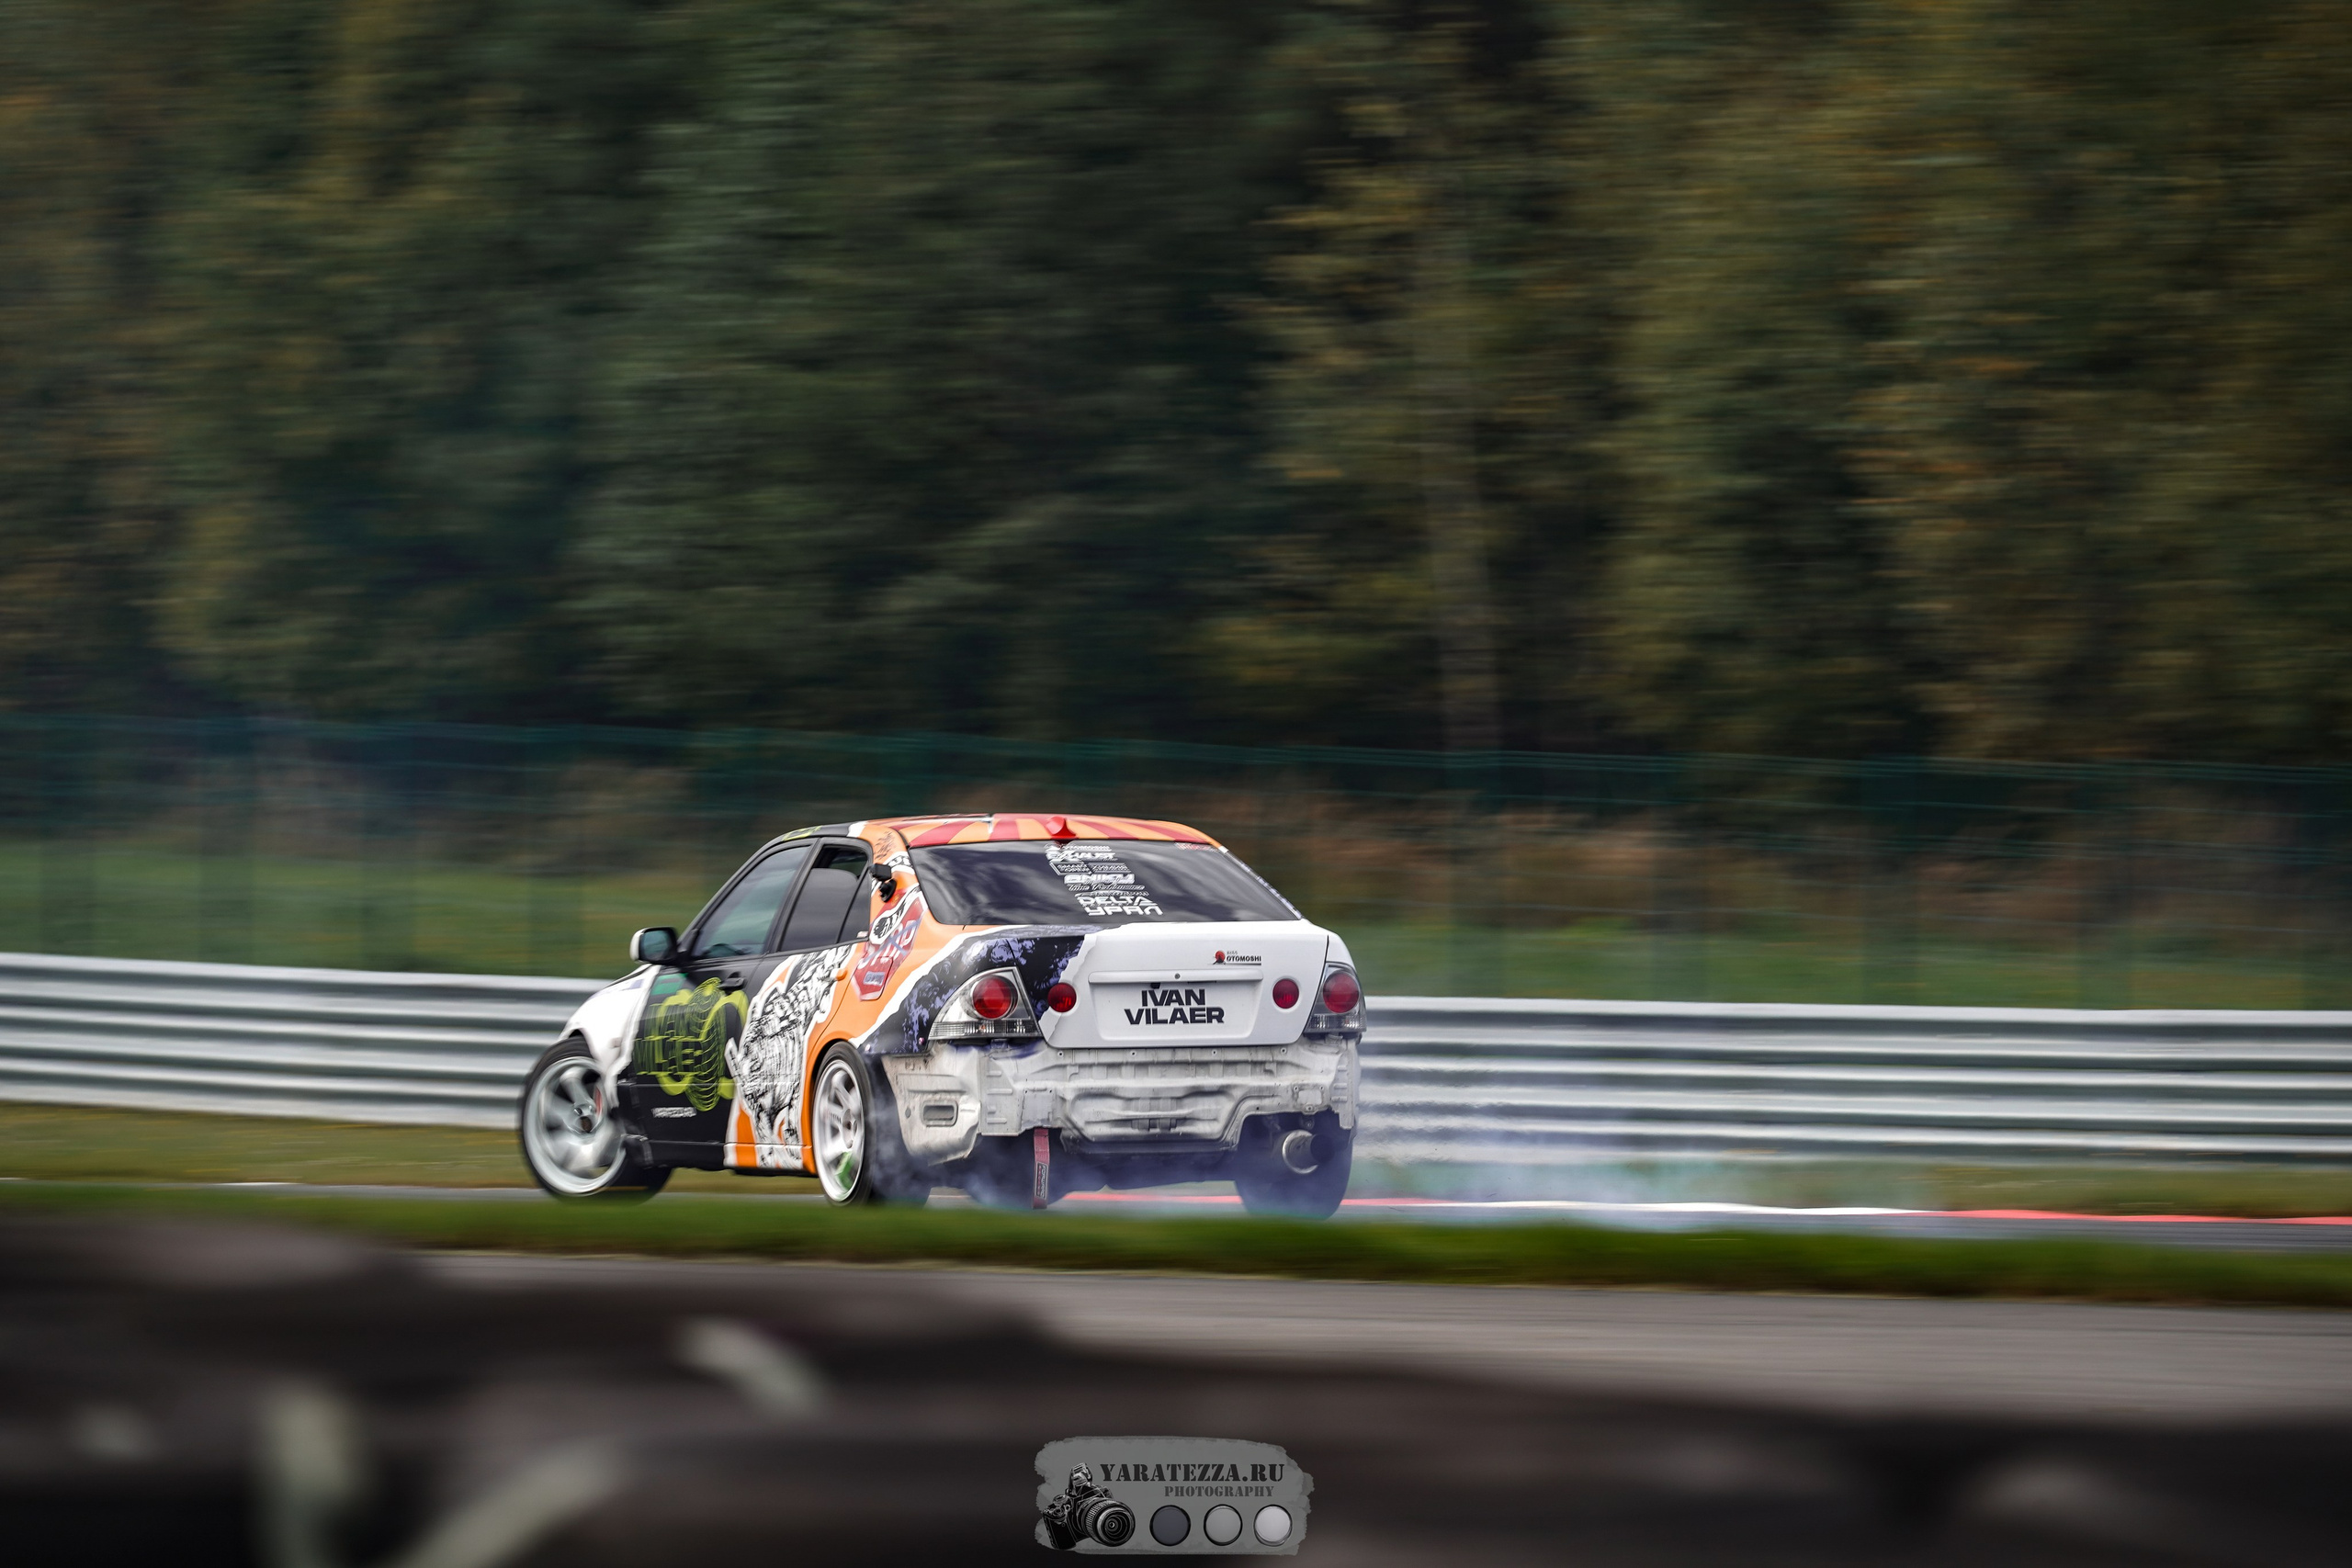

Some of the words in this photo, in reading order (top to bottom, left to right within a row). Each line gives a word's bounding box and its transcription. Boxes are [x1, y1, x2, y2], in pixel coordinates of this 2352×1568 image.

[1077, 896, 1158, 907] DELTA
[1141, 988, 1206, 1007] IVAN
[1125, 1007, 1225, 1025] VILAER
